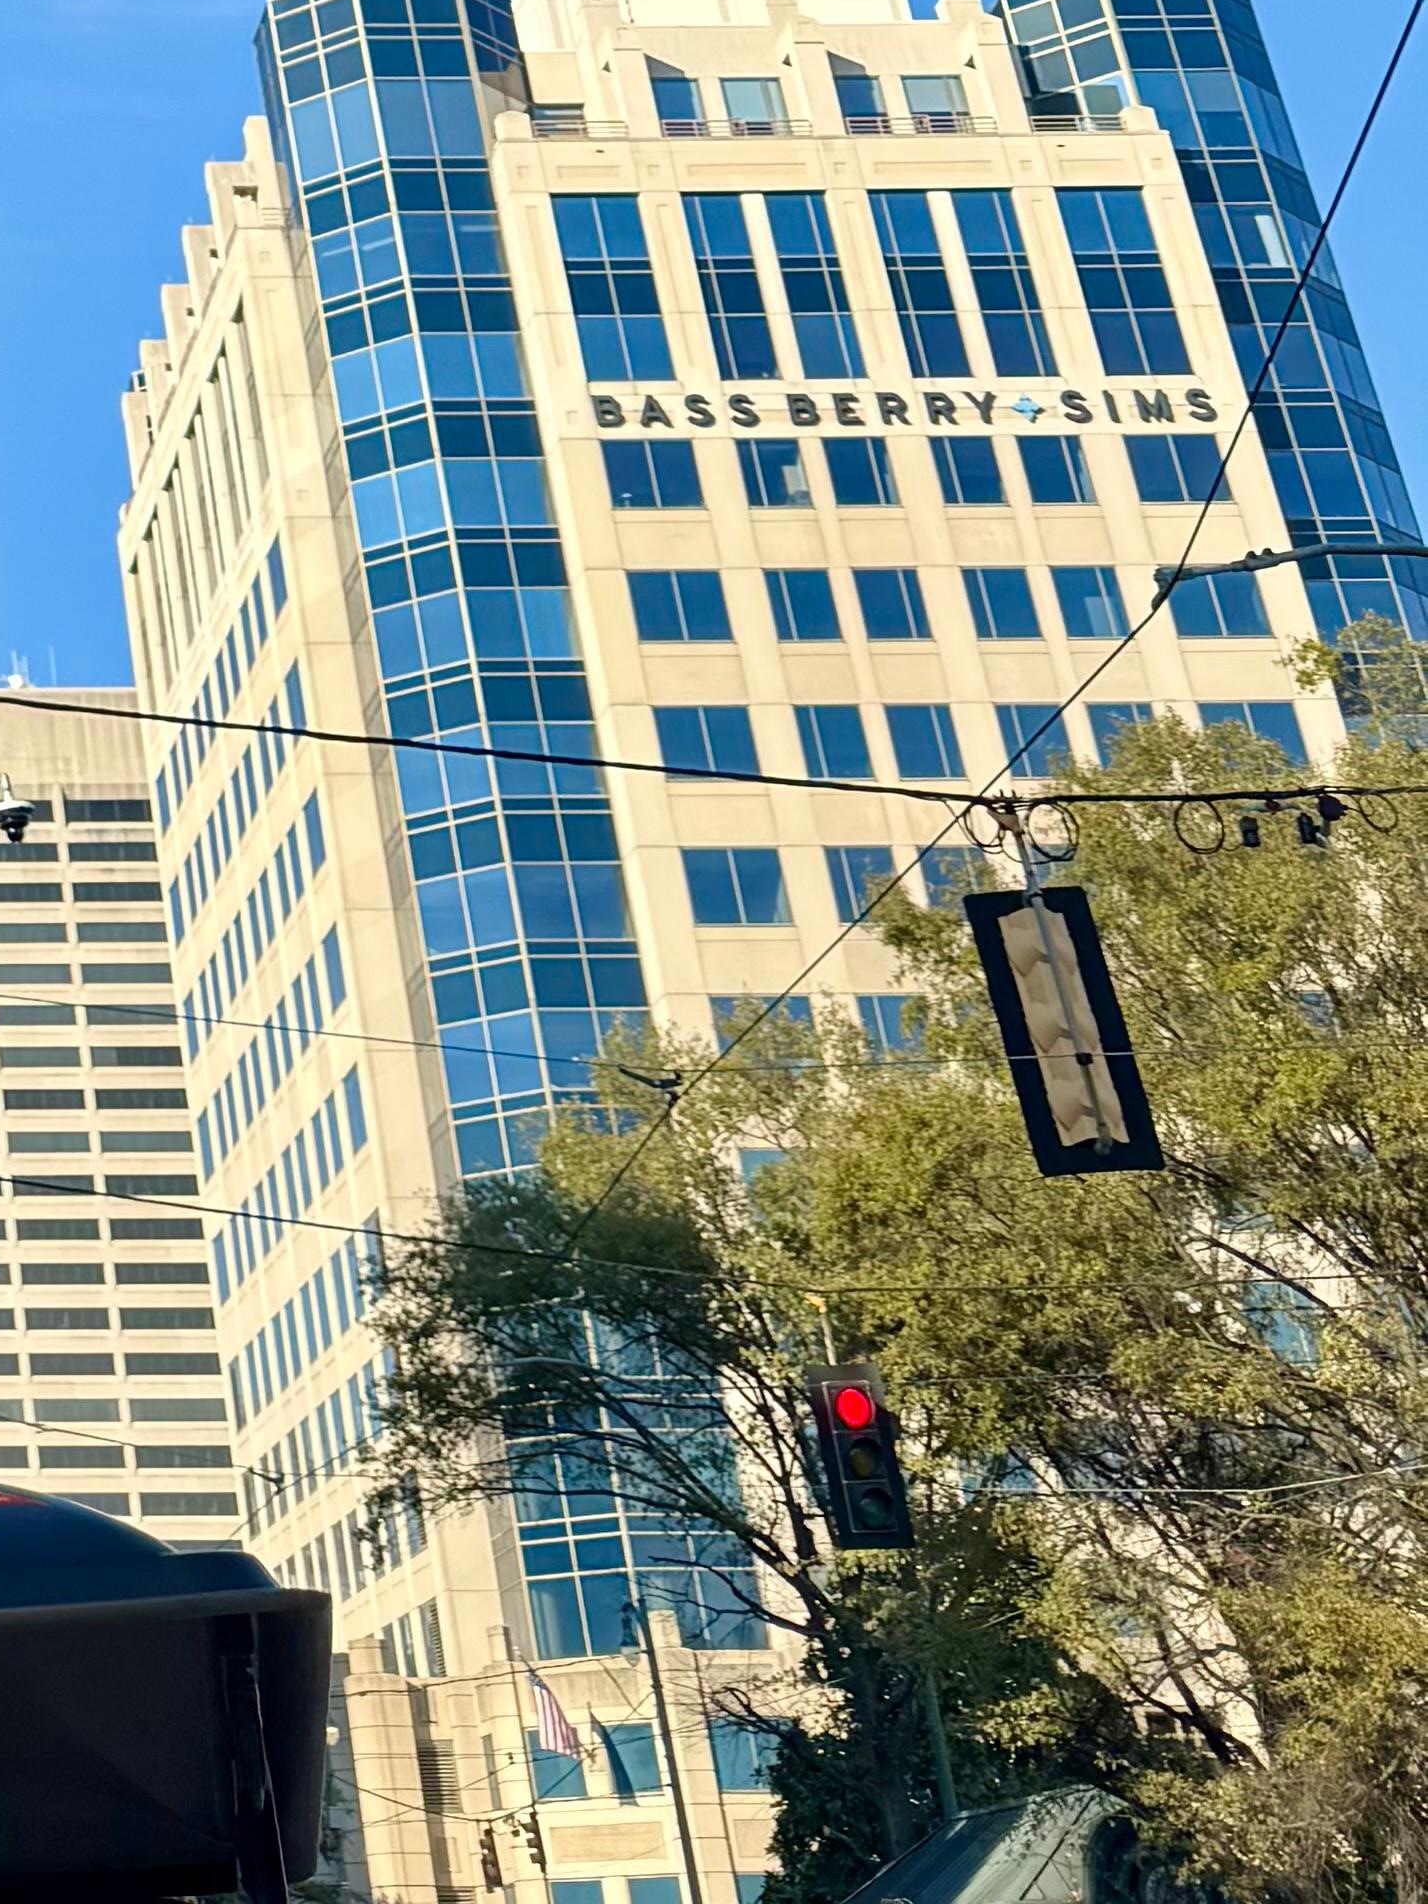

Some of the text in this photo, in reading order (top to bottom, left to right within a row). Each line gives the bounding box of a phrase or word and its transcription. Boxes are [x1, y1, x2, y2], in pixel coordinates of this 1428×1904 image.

[592, 387, 1220, 430] BASS BERRY SIMS
